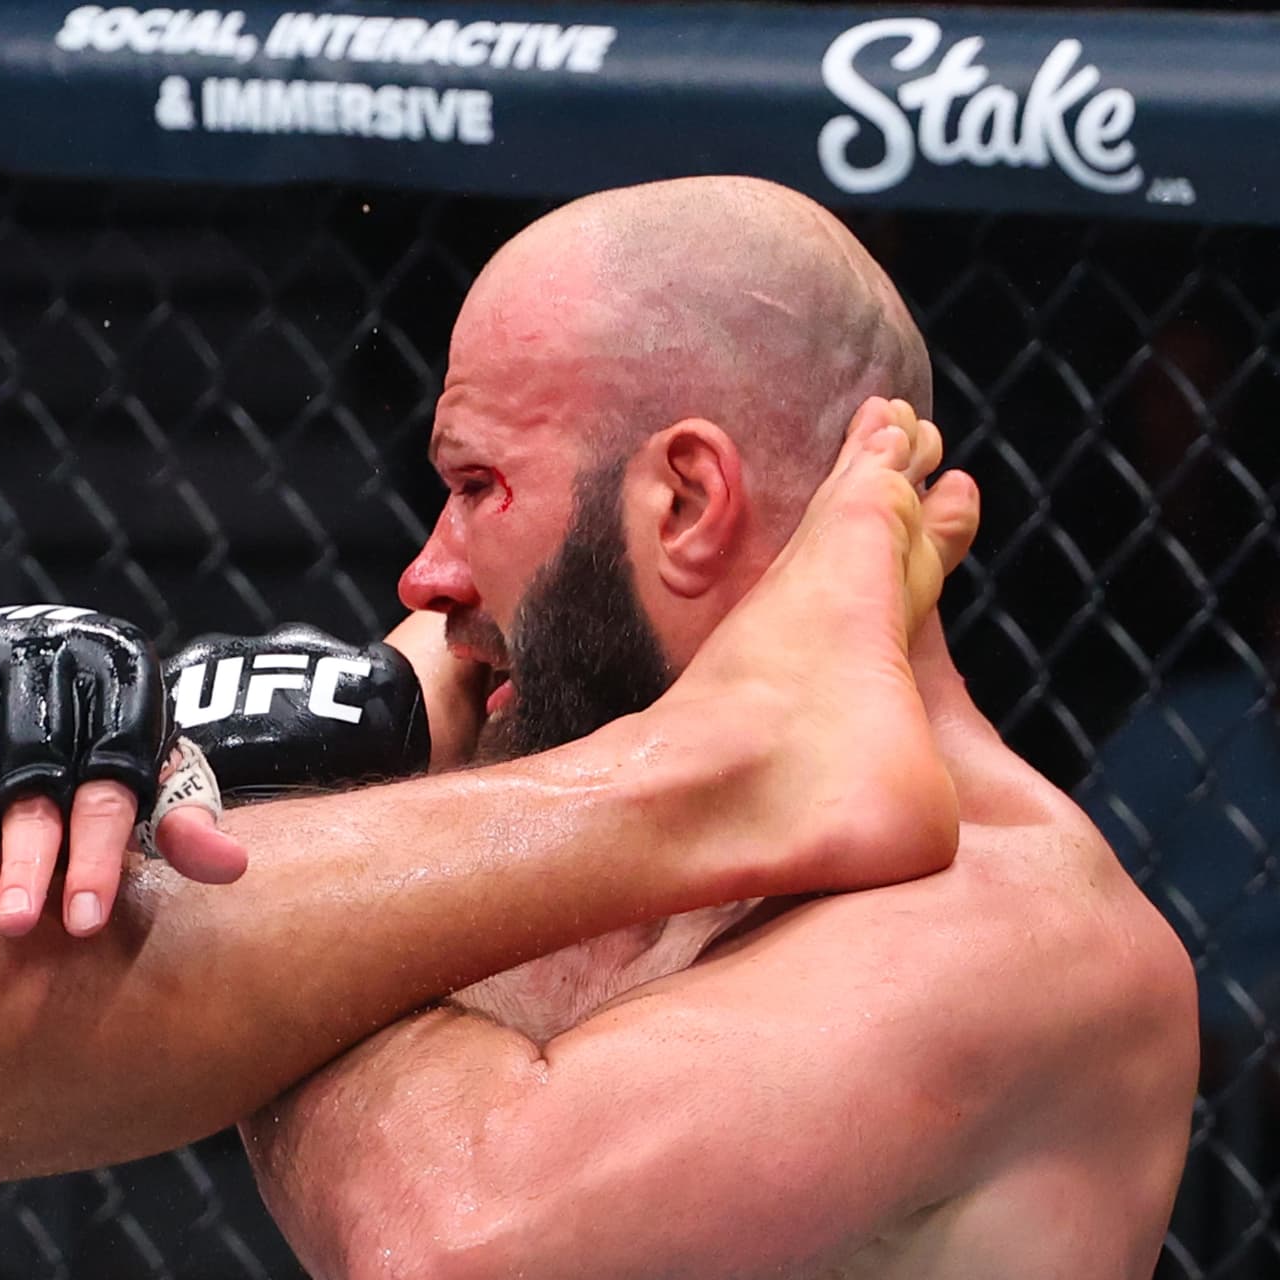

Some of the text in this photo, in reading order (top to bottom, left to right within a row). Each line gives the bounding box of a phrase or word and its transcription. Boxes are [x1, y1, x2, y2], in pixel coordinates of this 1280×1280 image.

[55, 4, 617, 74] SOCIAL, INTERACTIVE
[154, 74, 494, 145] & IMMERSIVE
[817, 17, 1143, 194] Stake
[174, 654, 372, 730] UFC
